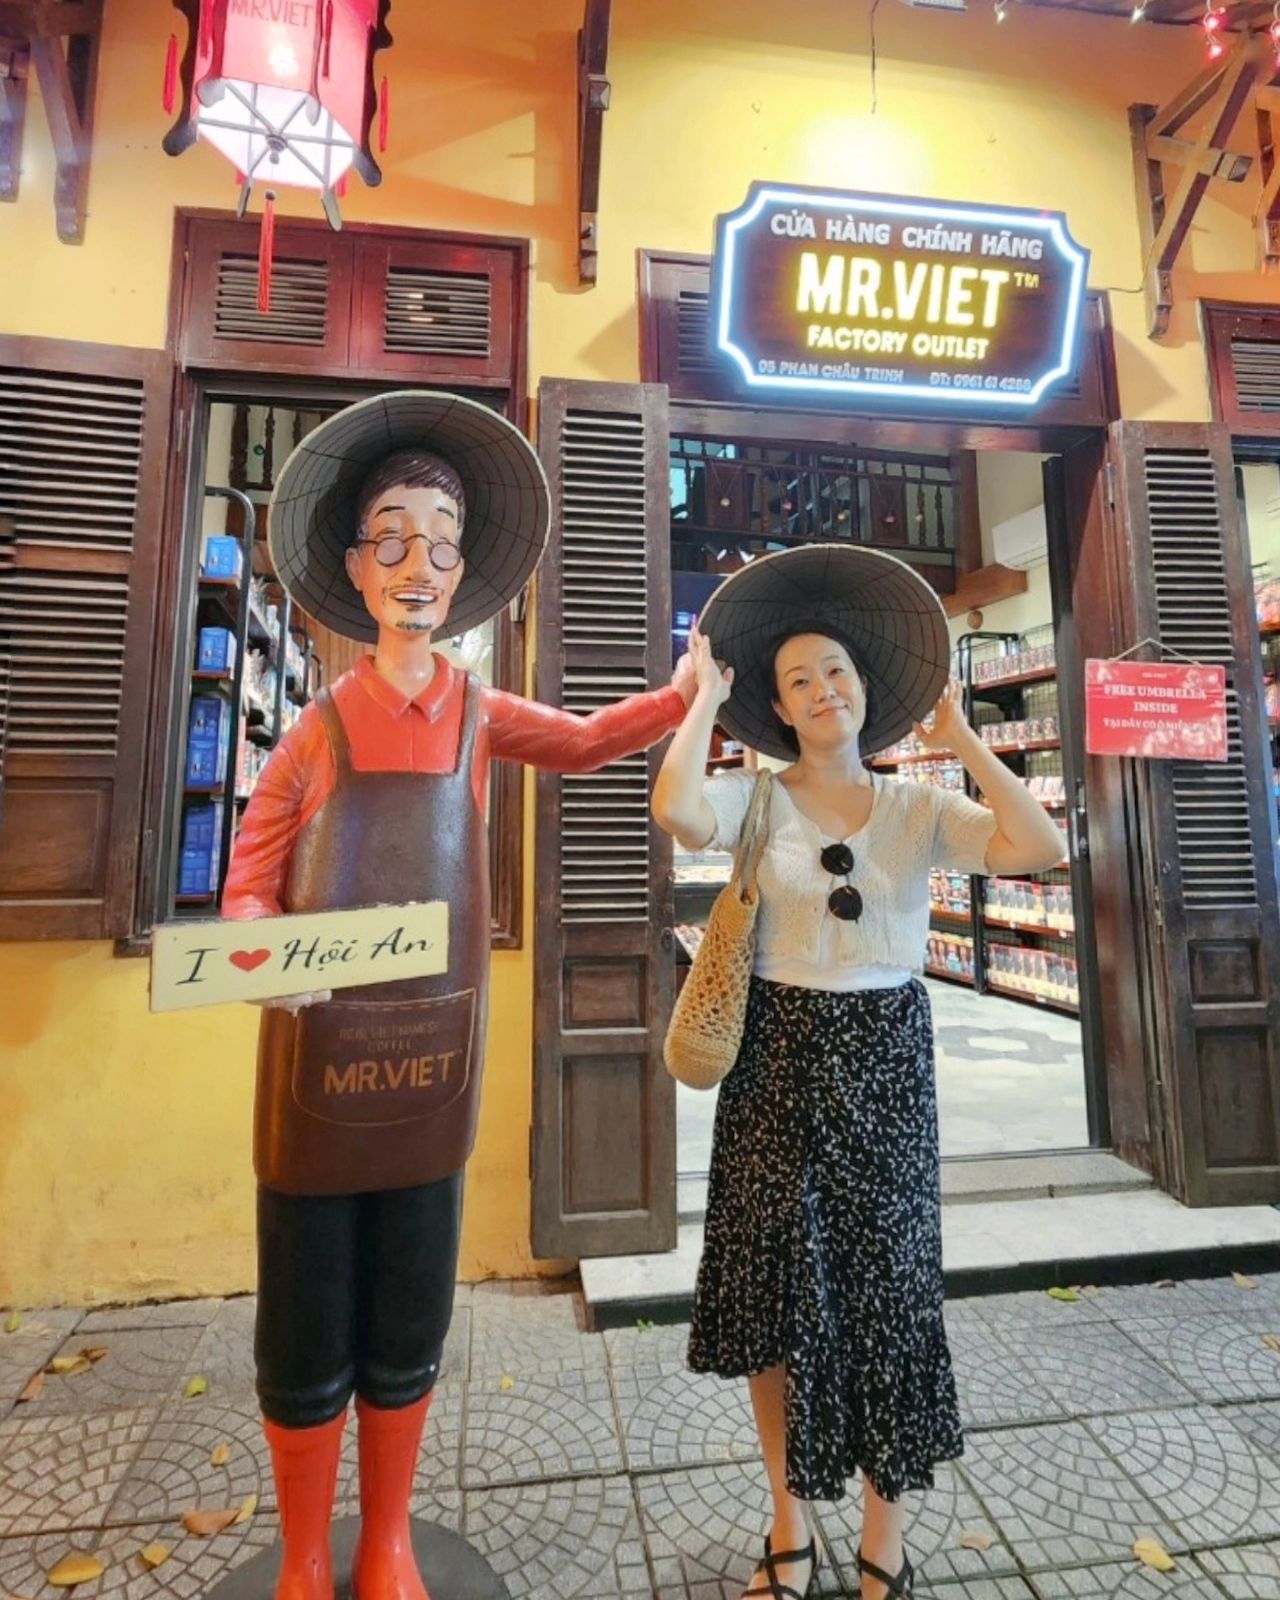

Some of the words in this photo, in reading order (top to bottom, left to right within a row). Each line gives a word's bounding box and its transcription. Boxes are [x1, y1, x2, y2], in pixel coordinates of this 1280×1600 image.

[231, 0, 314, 28] MR.VIET
[771, 209, 815, 239] CỬA
[826, 214, 890, 245] HÀNG
[902, 223, 972, 253] CHÍNH
[981, 230, 1043, 260] HÃNG
[796, 252, 1010, 328] MR.VIET
[808, 325, 905, 353] FACTORY
[912, 333, 989, 360] OUTLET
[780, 361, 818, 377] PHAN
[821, 362, 860, 380] CHÂU
[1104, 684, 1136, 697] FREE
[1137, 685, 1207, 699] UMBRELLA
[1133, 701, 1178, 714] INSIDE
[176, 948, 220, 985] I
[282, 936, 359, 972] Hội
[370, 926, 434, 961] An
[324, 1051, 455, 1096] MR.VIET
